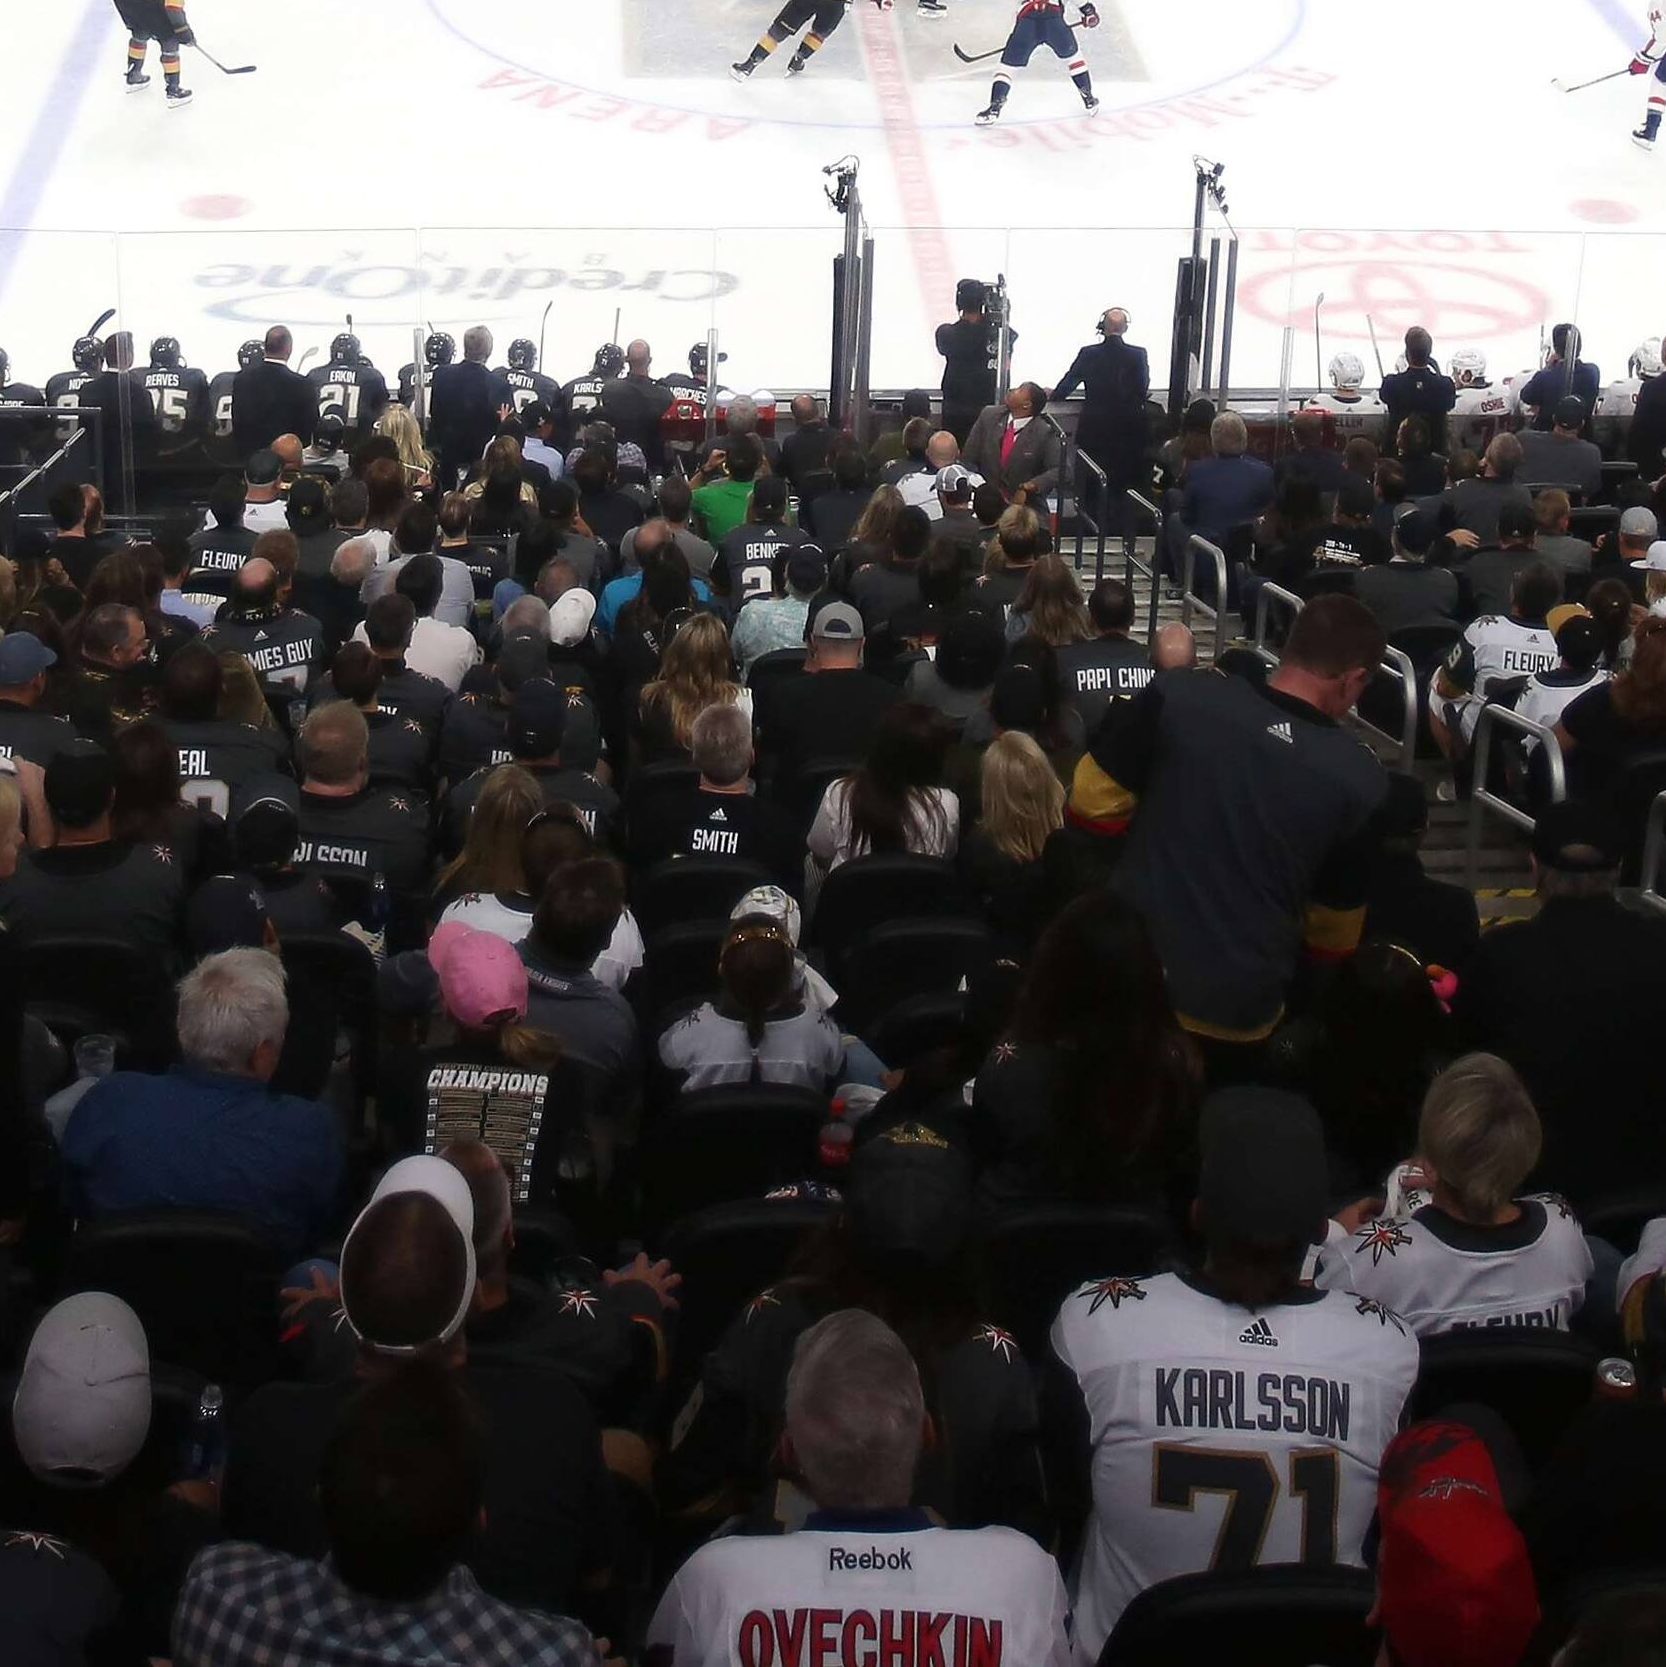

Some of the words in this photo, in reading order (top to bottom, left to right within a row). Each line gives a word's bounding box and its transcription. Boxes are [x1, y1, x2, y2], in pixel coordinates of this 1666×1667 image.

[1233, 228, 1534, 253] TOYOT
[145, 373, 180, 388] REAVES
[329, 370, 357, 384] EAKIN
[506, 372, 535, 388] SMITH
[201, 549, 247, 572] FLEURY
[745, 542, 789, 561] BENN
[286, 638, 314, 663] GUY
[1503, 649, 1554, 674] FLEURY
[1075, 669, 1111, 693] PAPI
[1117, 667, 1156, 690] CHIN
[178, 749, 211, 775] EAL
[691, 828, 739, 855] SMITH
[426, 1067, 550, 1098] CHAMPIONS
[1238, 1332, 1279, 1348] adidas
[1155, 1368, 1351, 1443] KARLSSON
[1150, 1440, 1341, 1570] 71
[829, 1546, 913, 1572] Reebok
[738, 1609, 1003, 1667] OVECHKIN
